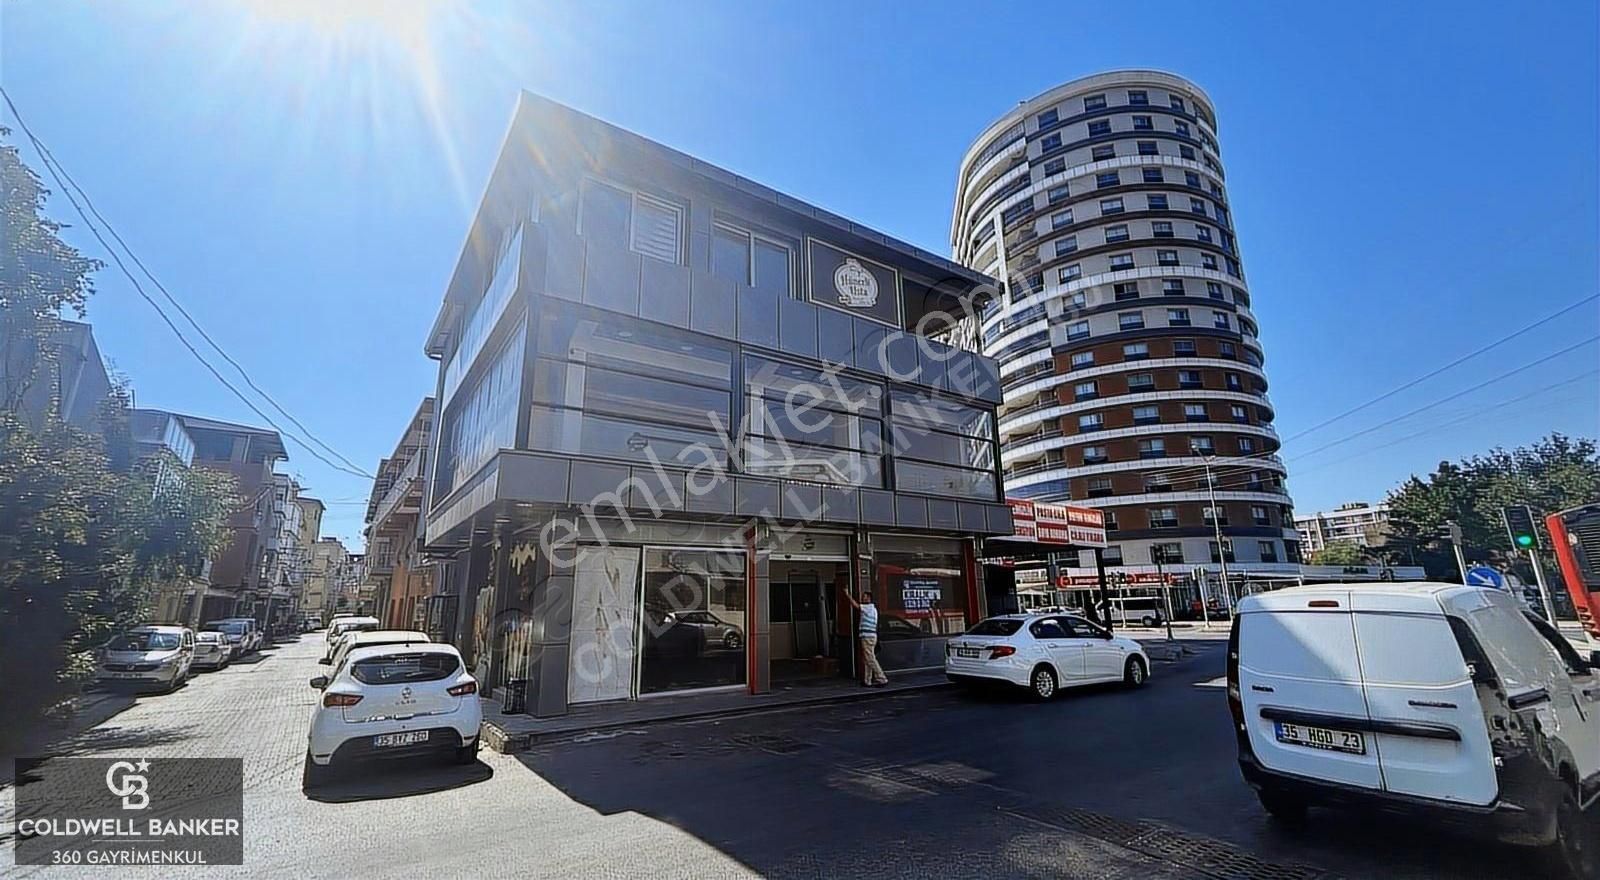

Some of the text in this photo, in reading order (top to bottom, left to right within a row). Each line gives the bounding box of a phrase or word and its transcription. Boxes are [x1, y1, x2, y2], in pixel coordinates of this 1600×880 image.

[1282, 724, 1298, 738] 35
[1307, 728, 1333, 744] HGD
[1341, 733, 1360, 748] 23
